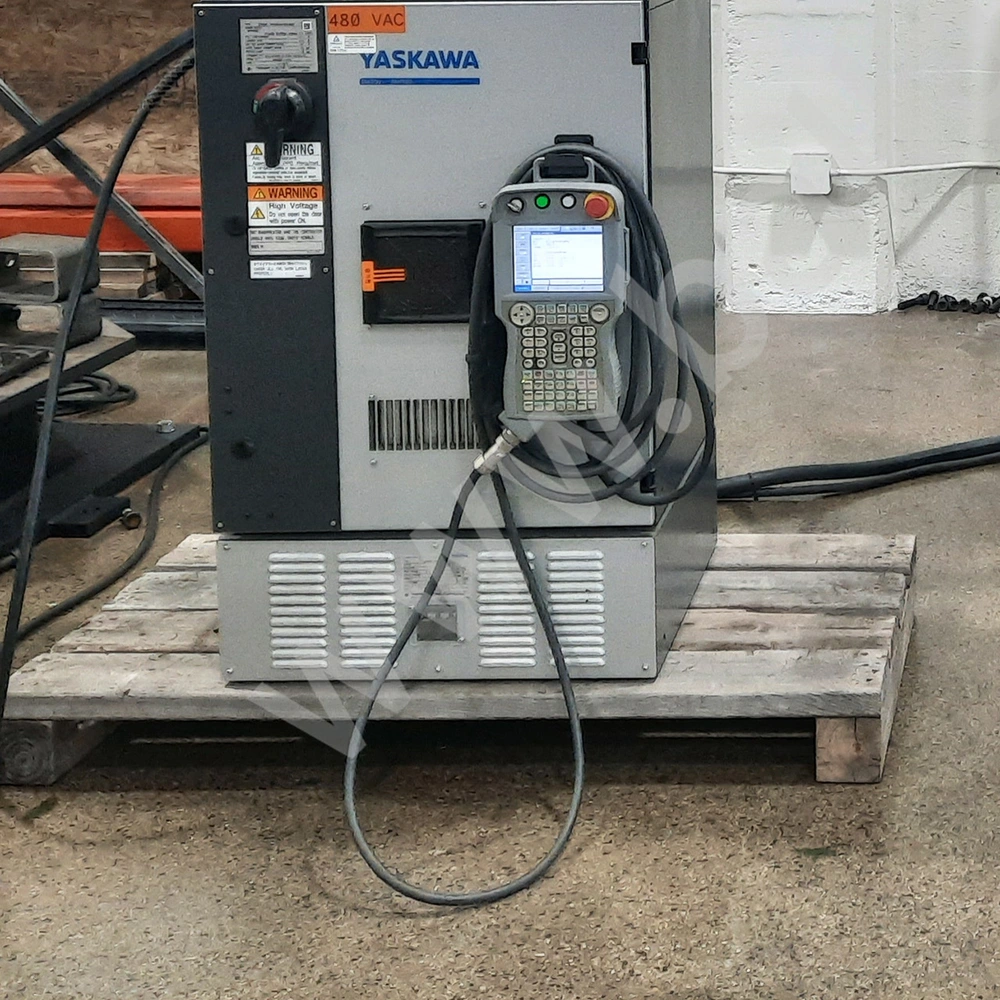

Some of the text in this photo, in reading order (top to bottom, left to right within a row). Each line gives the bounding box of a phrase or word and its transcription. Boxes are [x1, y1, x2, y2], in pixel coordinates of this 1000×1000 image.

[329, 13, 405, 27] 480 VAC
[360, 50, 480, 70] YASKAWA
[282, 143, 315, 156] RNING
[268, 187, 318, 199] WARNING
[268, 203, 286, 211] High
